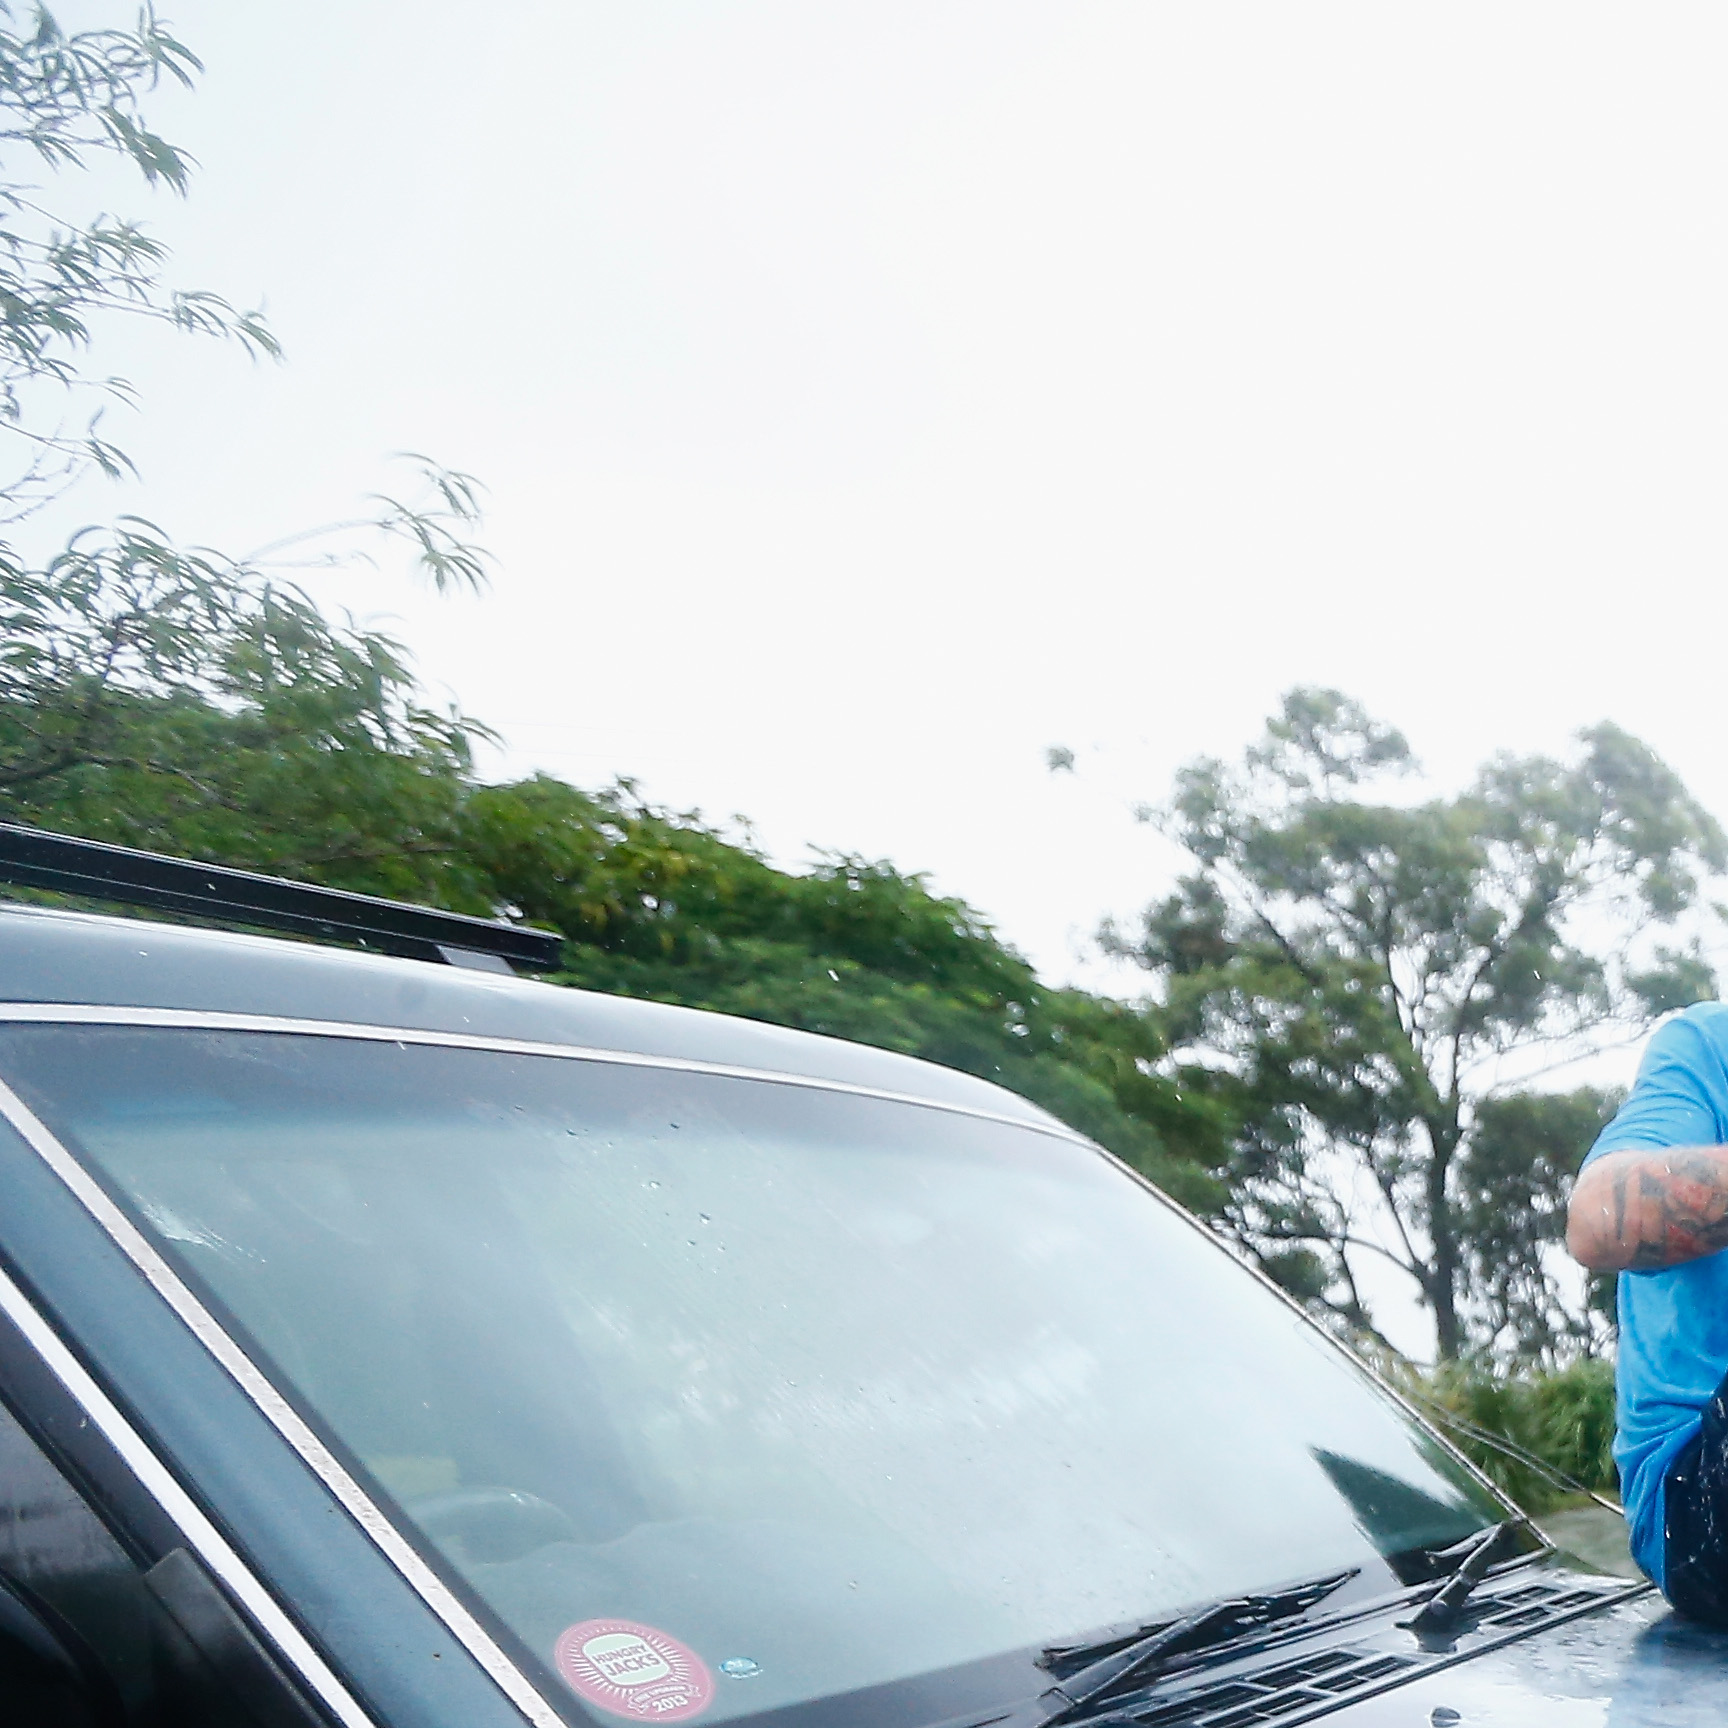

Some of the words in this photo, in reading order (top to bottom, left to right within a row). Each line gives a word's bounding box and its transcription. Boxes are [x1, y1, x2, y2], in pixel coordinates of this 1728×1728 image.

[591, 1645, 647, 1664] HUNGRY
[605, 1653, 660, 1676] JACKS
[652, 1695, 688, 1712] 2013
